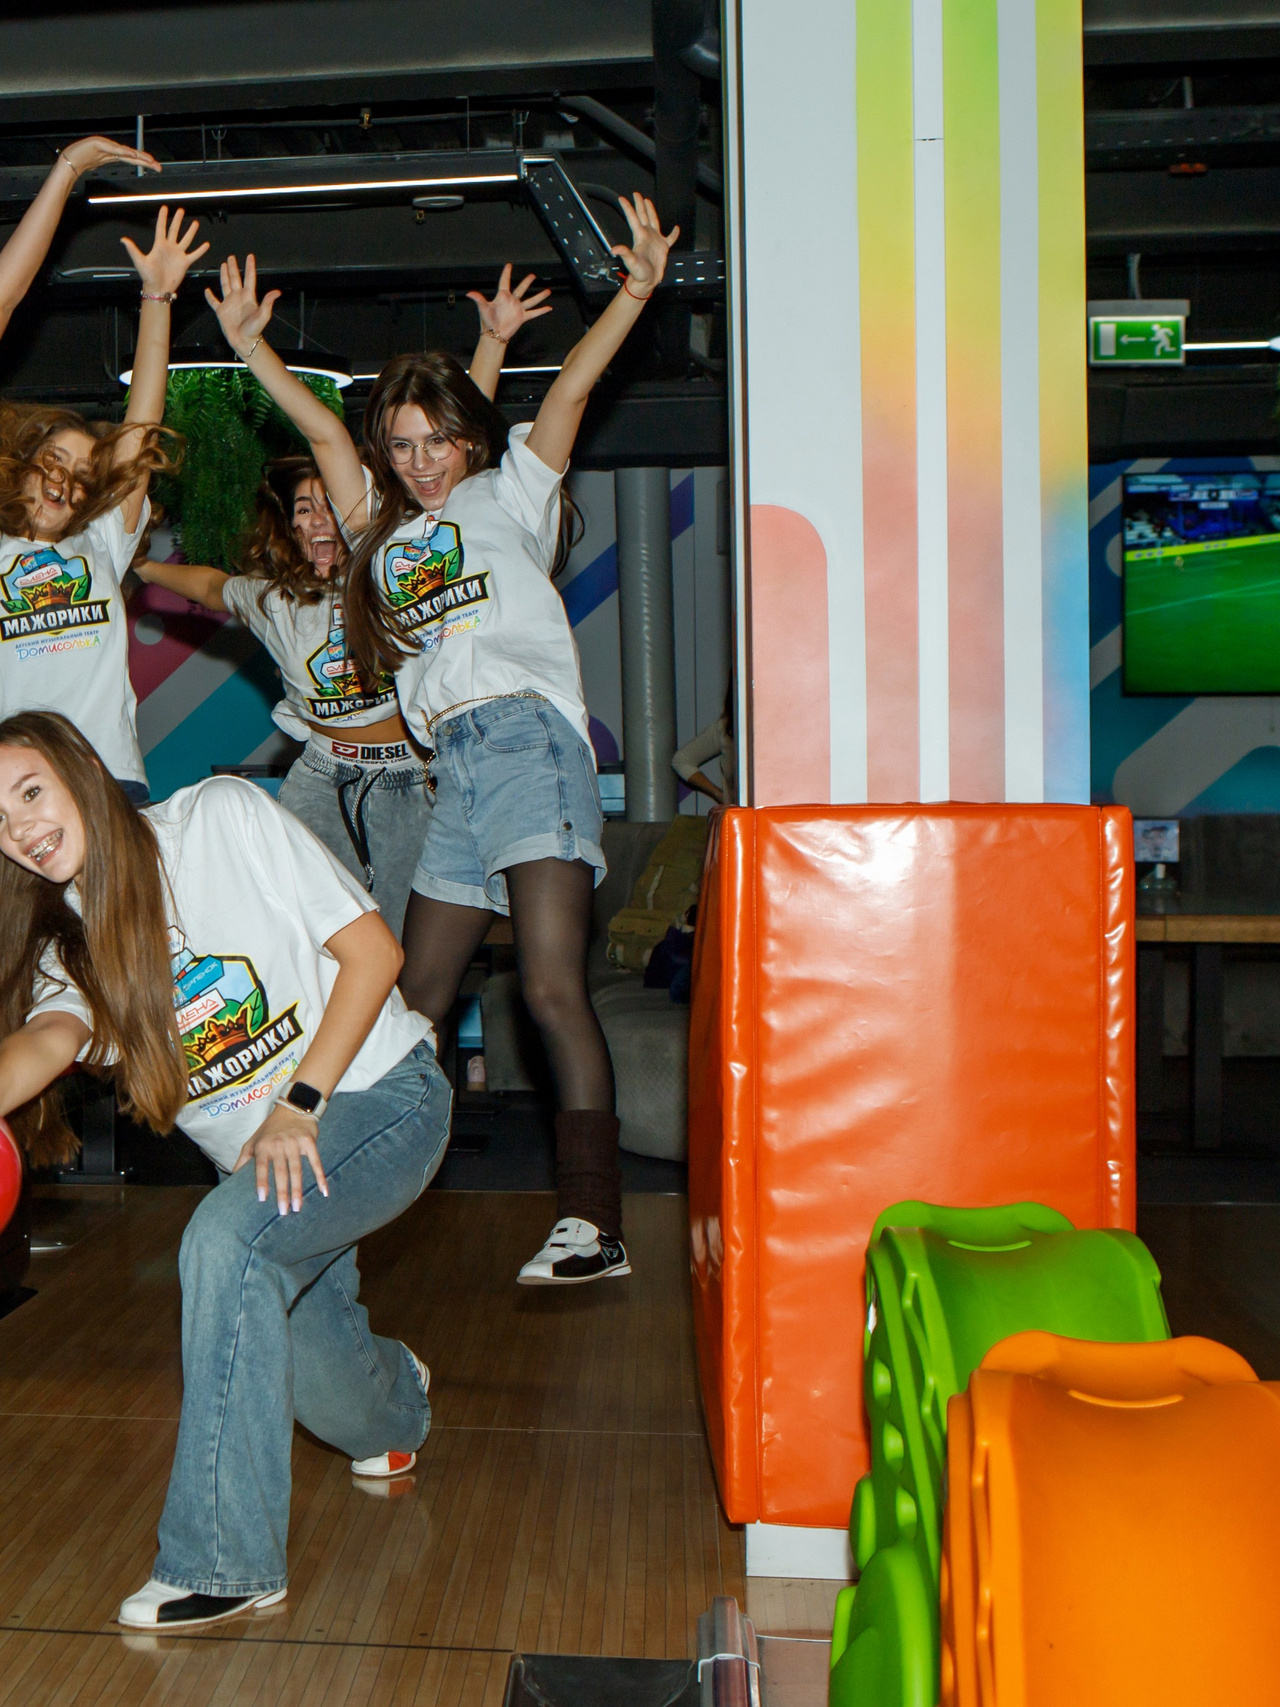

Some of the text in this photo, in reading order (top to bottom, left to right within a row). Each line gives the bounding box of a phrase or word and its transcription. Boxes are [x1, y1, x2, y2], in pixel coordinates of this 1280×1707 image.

[394, 579, 482, 630] МАЖОРИКИ
[462, 610, 478, 618] ТЕАТР
[3, 604, 103, 637] МАЖОРИКИ
[314, 691, 395, 716] МАЖОРИК
[342, 756, 389, 764] SUCCESSFUL
[390, 755, 412, 763] LIVING
[360, 743, 409, 760] DIESEL
[177, 998, 217, 1026] МЕНА
[279, 1051, 295, 1066] ТЕАТР
